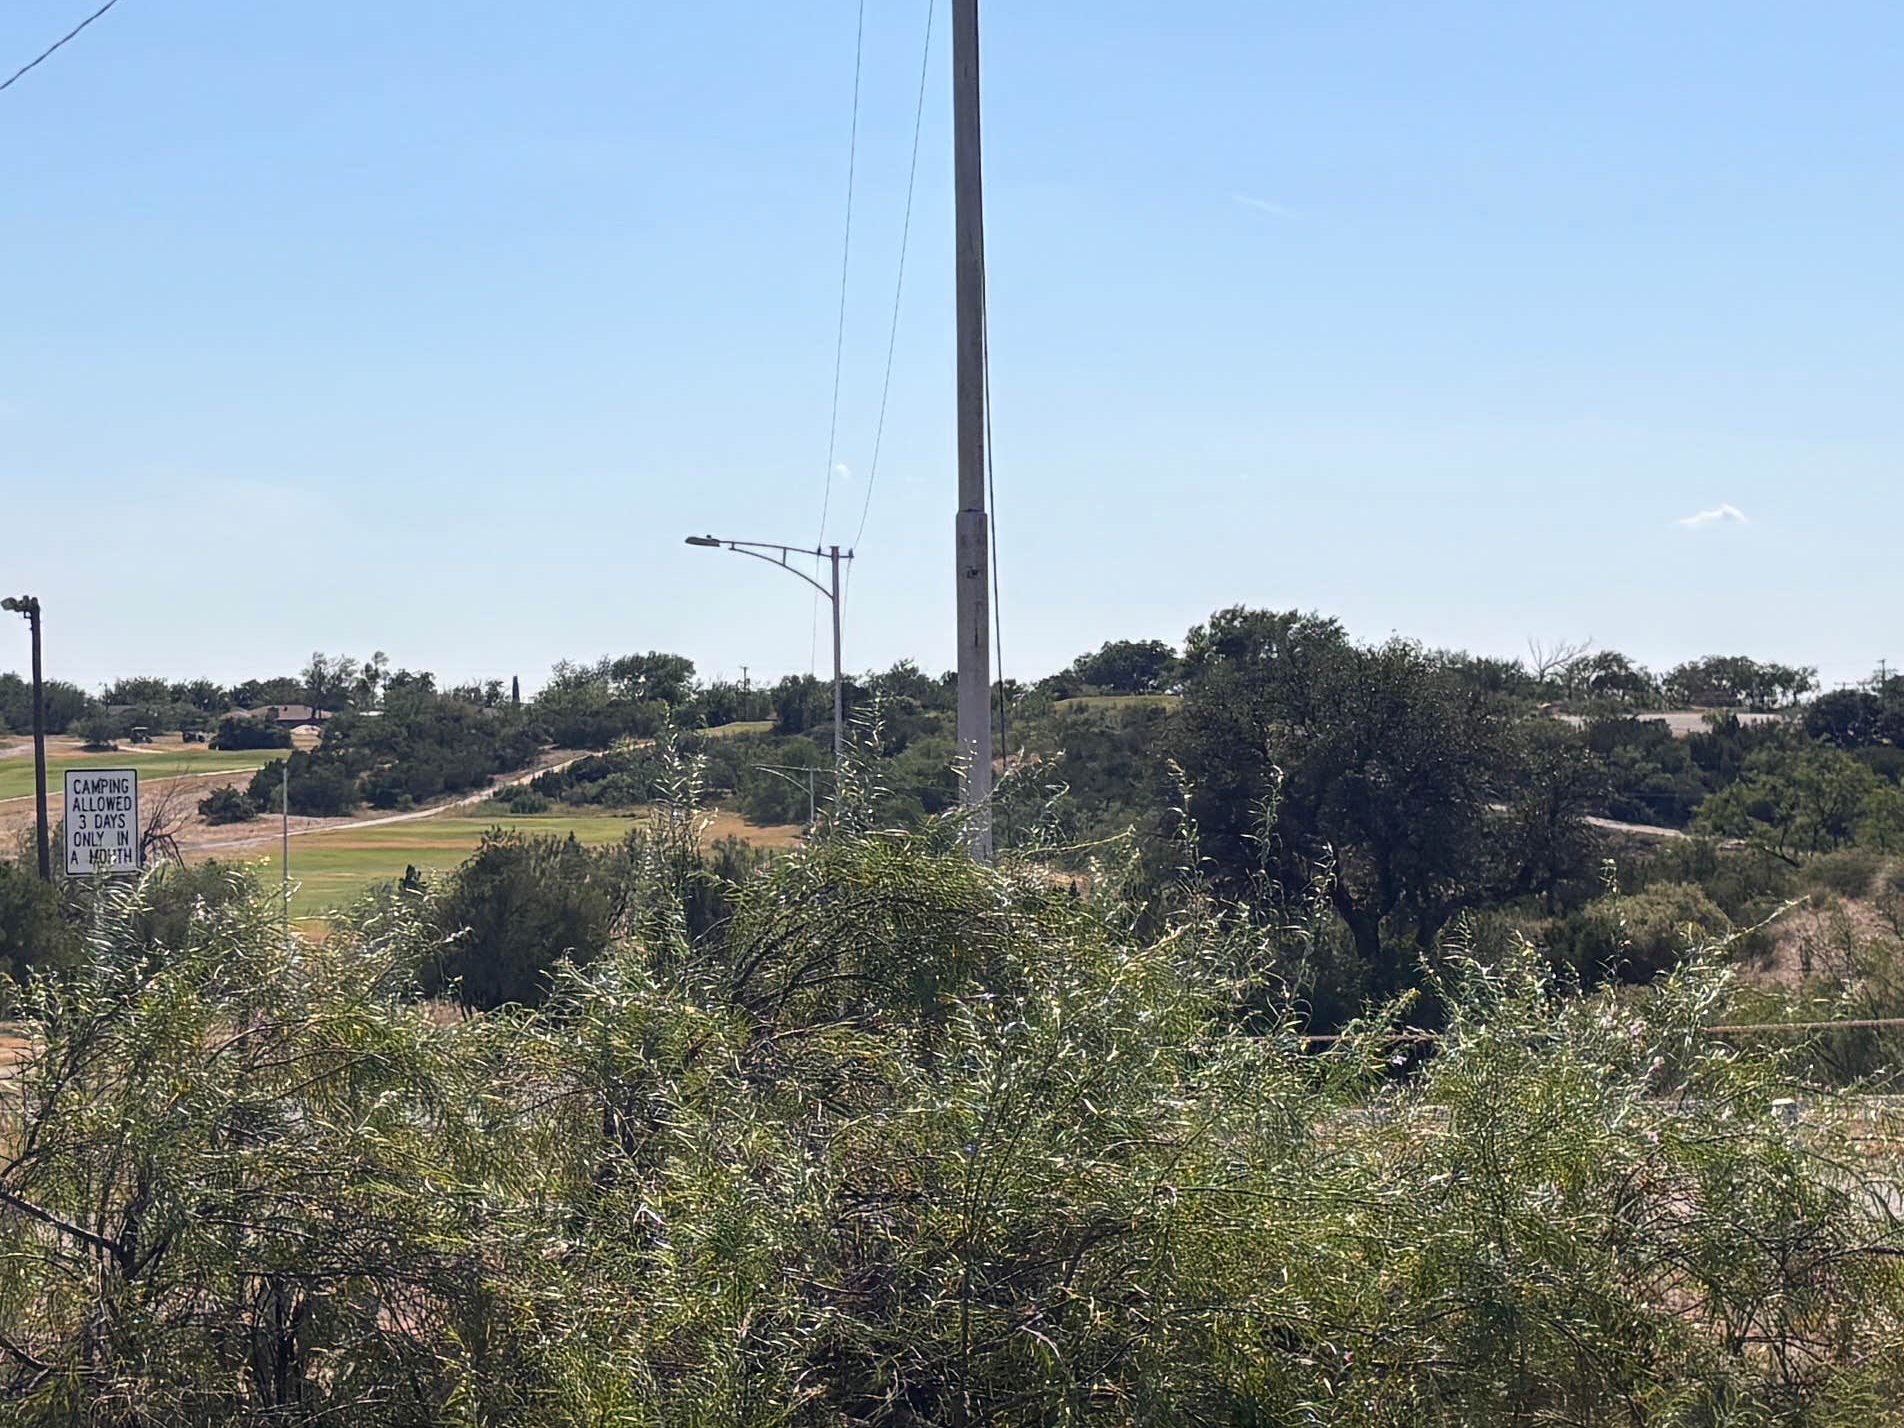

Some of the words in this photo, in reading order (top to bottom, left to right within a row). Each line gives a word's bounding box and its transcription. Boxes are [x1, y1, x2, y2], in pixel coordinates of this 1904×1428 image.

[74, 779, 128, 794] CAMPING
[73, 796, 132, 811] ALLOWED
[80, 815, 86, 829] 3
[95, 815, 125, 829] DAYS
[74, 832, 104, 846] ONLY
[118, 831, 128, 845] IN
[71, 850, 78, 864] A
